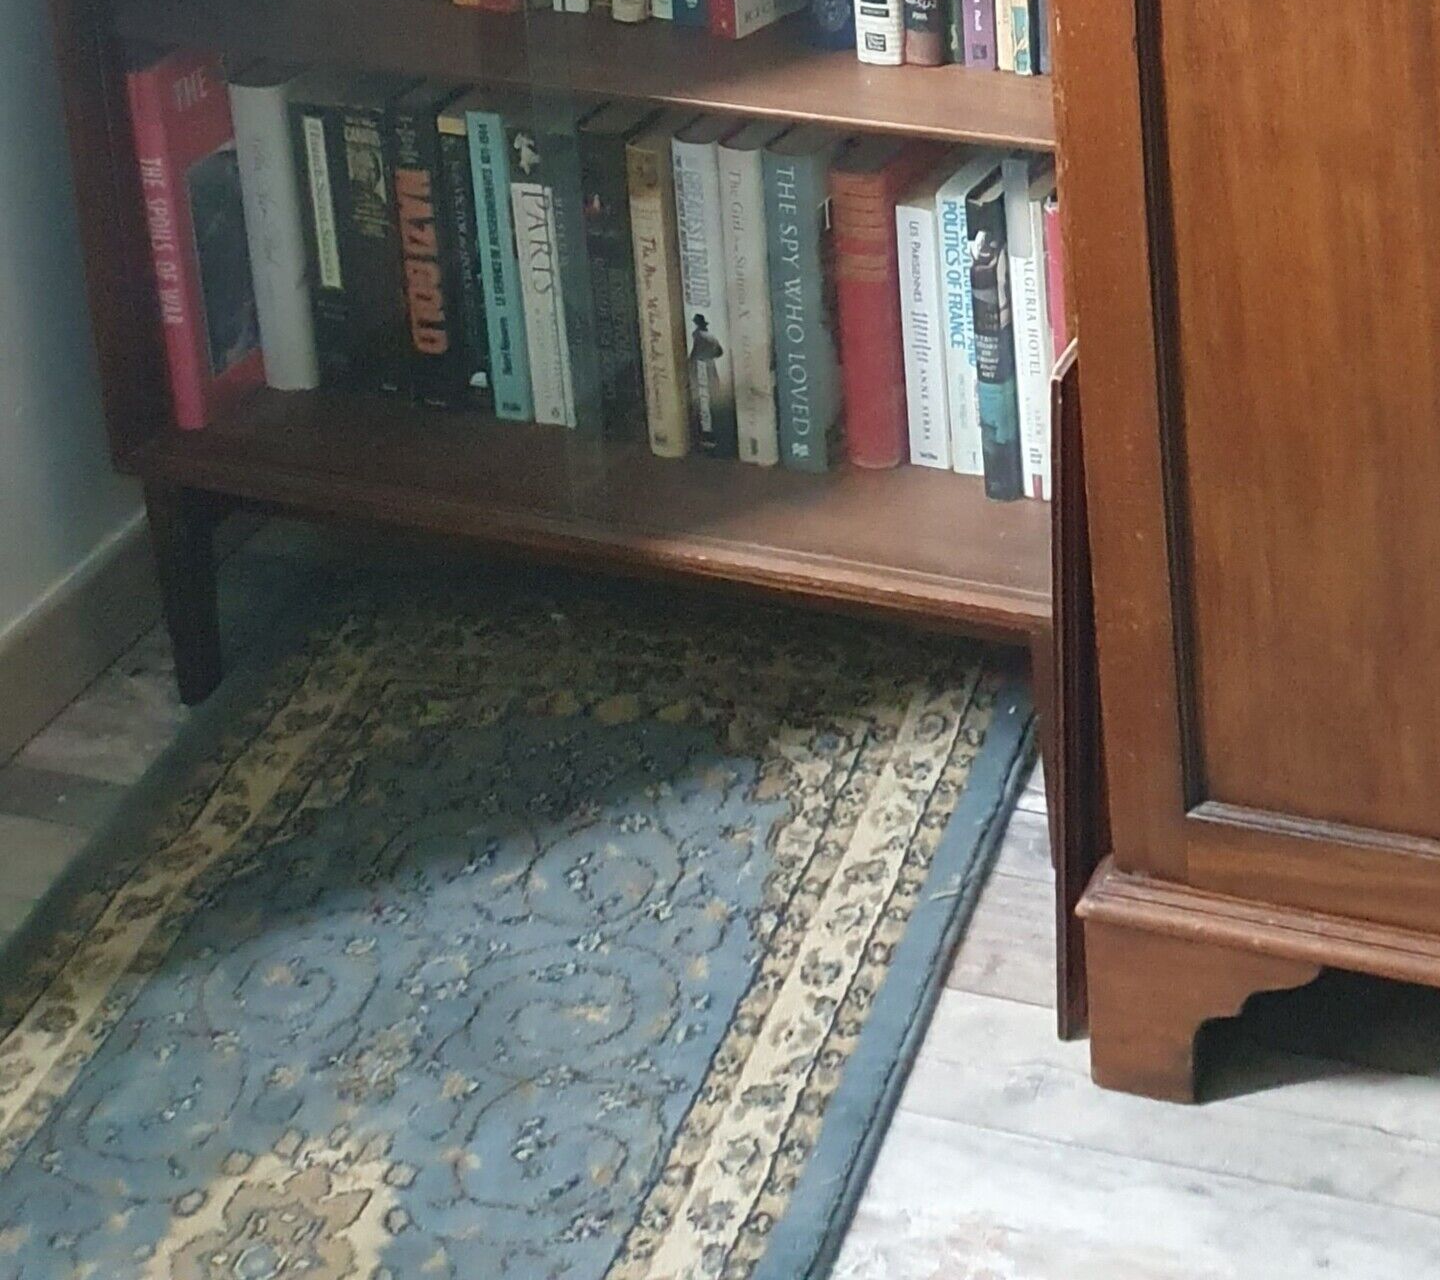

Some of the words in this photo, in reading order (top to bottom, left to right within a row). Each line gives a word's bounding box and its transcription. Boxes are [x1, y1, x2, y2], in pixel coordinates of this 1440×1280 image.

[139, 157, 166, 189] THE
[776, 166, 797, 214] THE
[147, 197, 176, 251] SPOILS
[732, 200, 744, 232] Girl
[941, 200, 961, 267] POLITICS
[156, 260, 180, 281] OF
[780, 225, 800, 272] SPY
[405, 257, 449, 355] GOLD
[947, 269, 963, 294] OF
[1022, 258, 1041, 322] ALGERIA
[160, 289, 184, 325] WAR
[784, 277, 806, 343] WHO
[948, 297, 966, 349] FRANCE
[1027, 327, 1043, 377] HOTEL
[788, 354, 811, 438] LOVED
